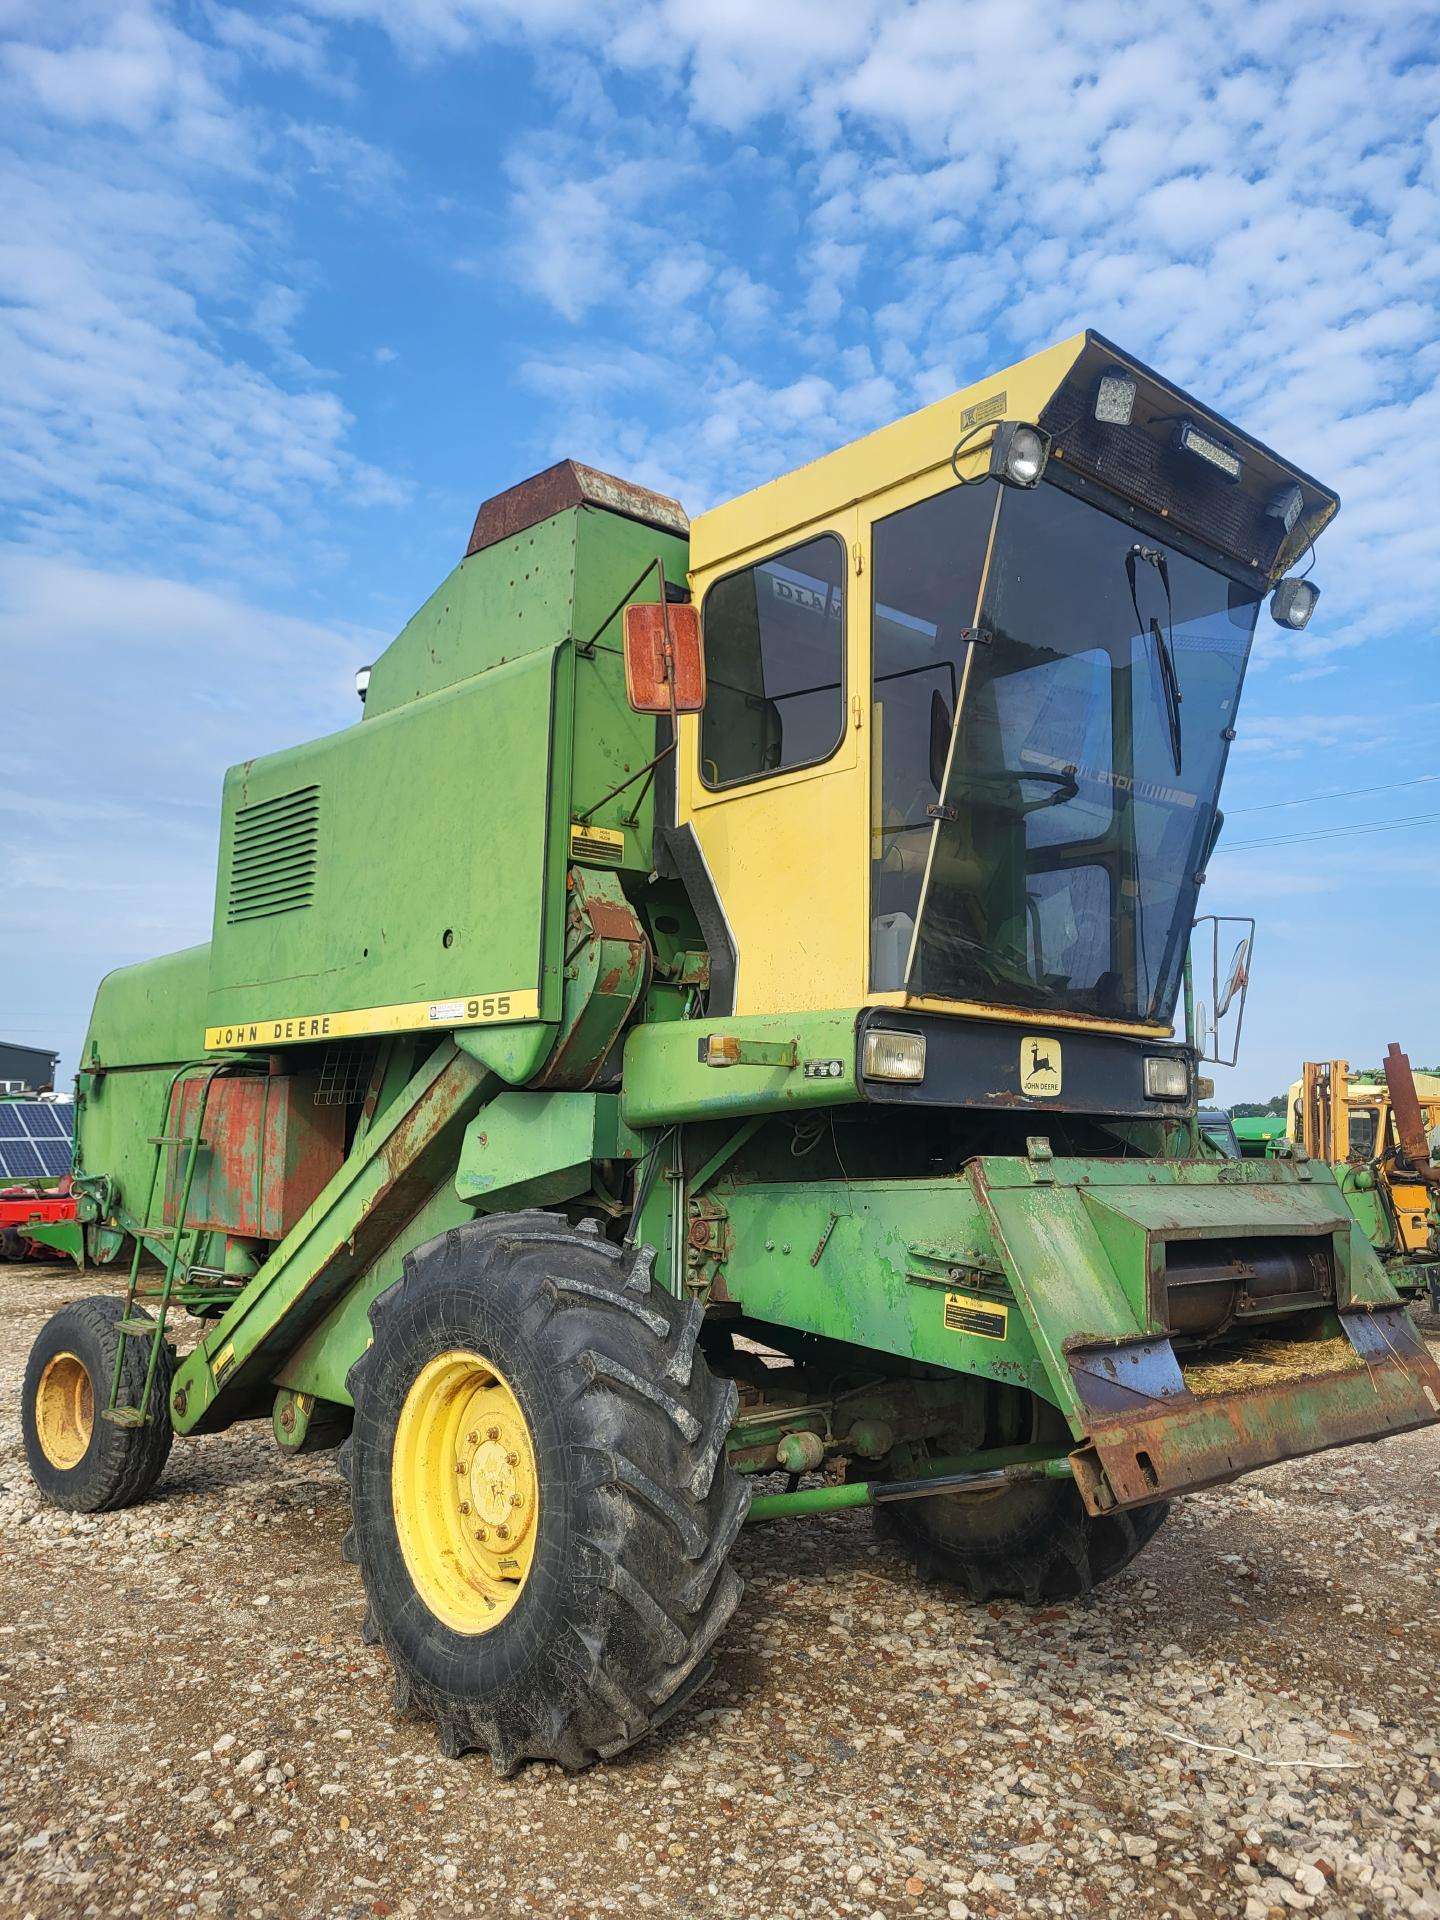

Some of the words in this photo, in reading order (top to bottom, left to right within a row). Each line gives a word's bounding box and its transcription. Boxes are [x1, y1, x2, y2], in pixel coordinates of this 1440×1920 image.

[467, 996, 511, 1019] 955
[215, 1023, 257, 1045] JOHN
[274, 1017, 330, 1039] DEERE
[1024, 1082, 1039, 1090] JOHN
[1040, 1083, 1059, 1091] DEERE
